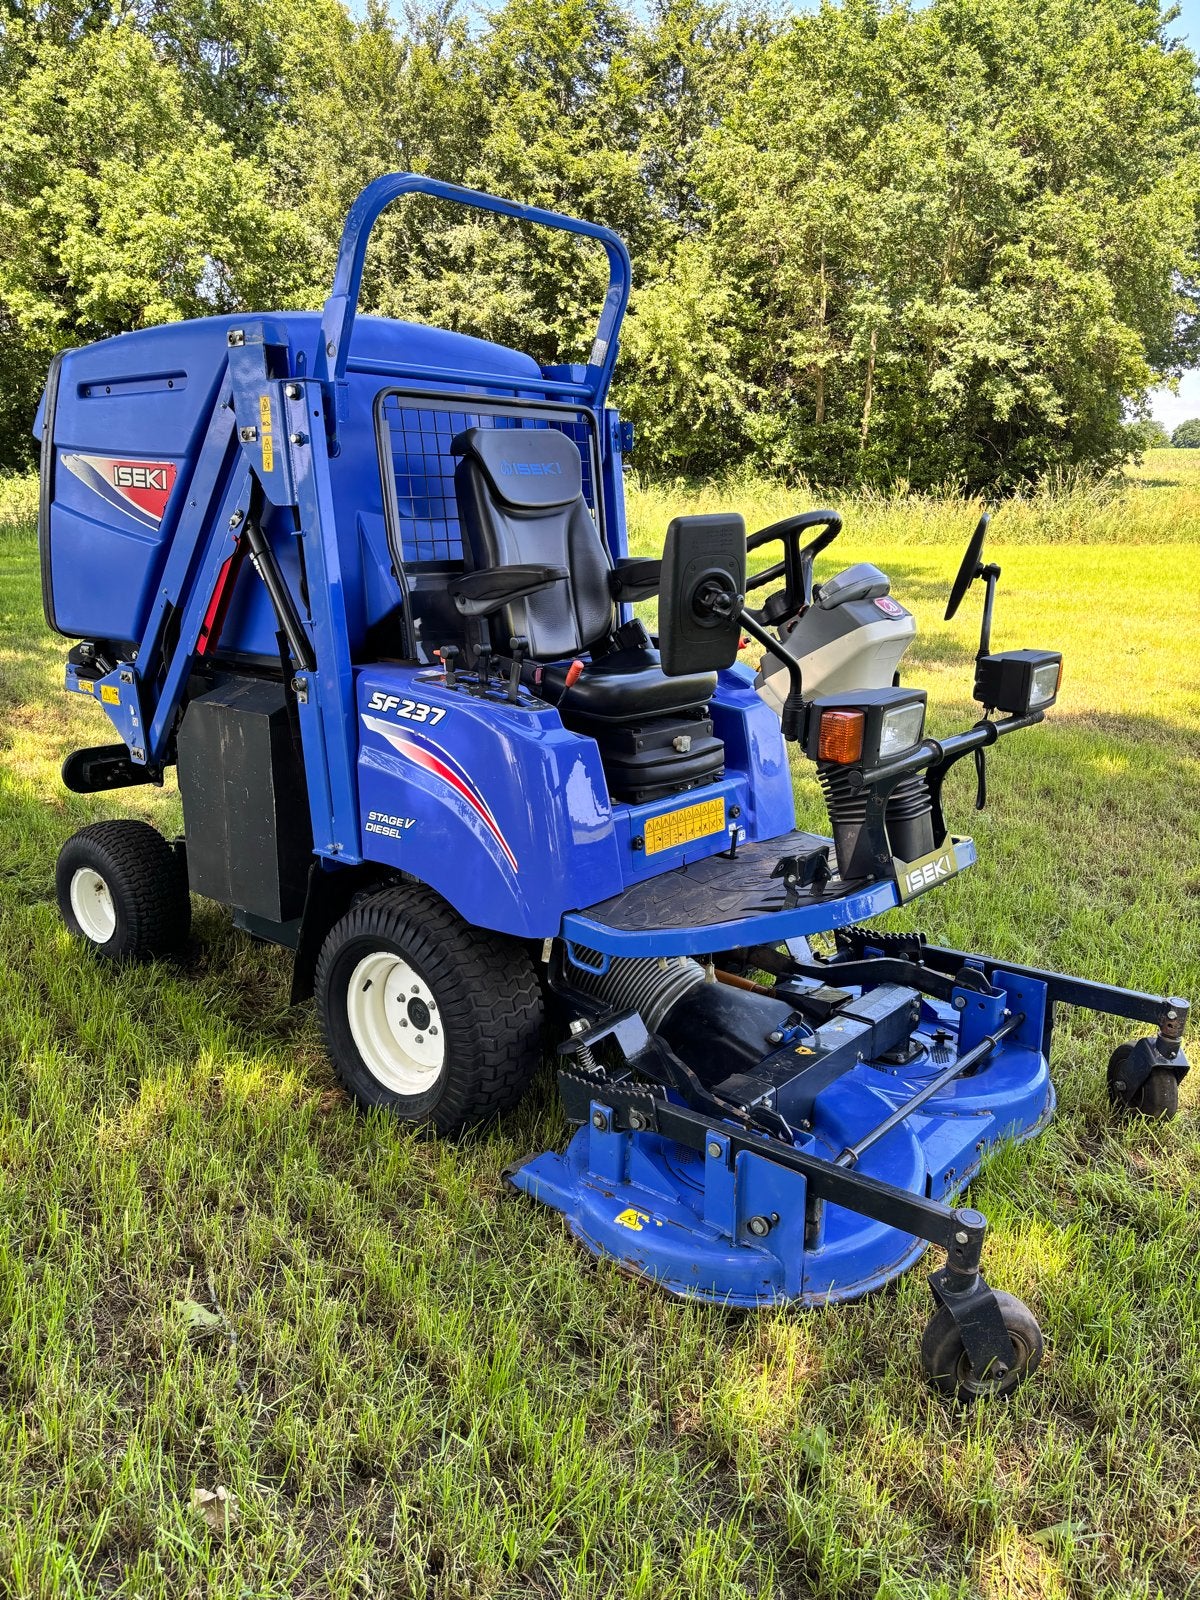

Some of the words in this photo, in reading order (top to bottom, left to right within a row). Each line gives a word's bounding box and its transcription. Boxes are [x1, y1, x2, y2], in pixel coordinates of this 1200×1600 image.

[113, 465, 167, 490] ISEKI
[512, 461, 562, 475] ISEKI
[365, 822, 402, 839] DIESEL
[905, 854, 952, 893] ISEKI
